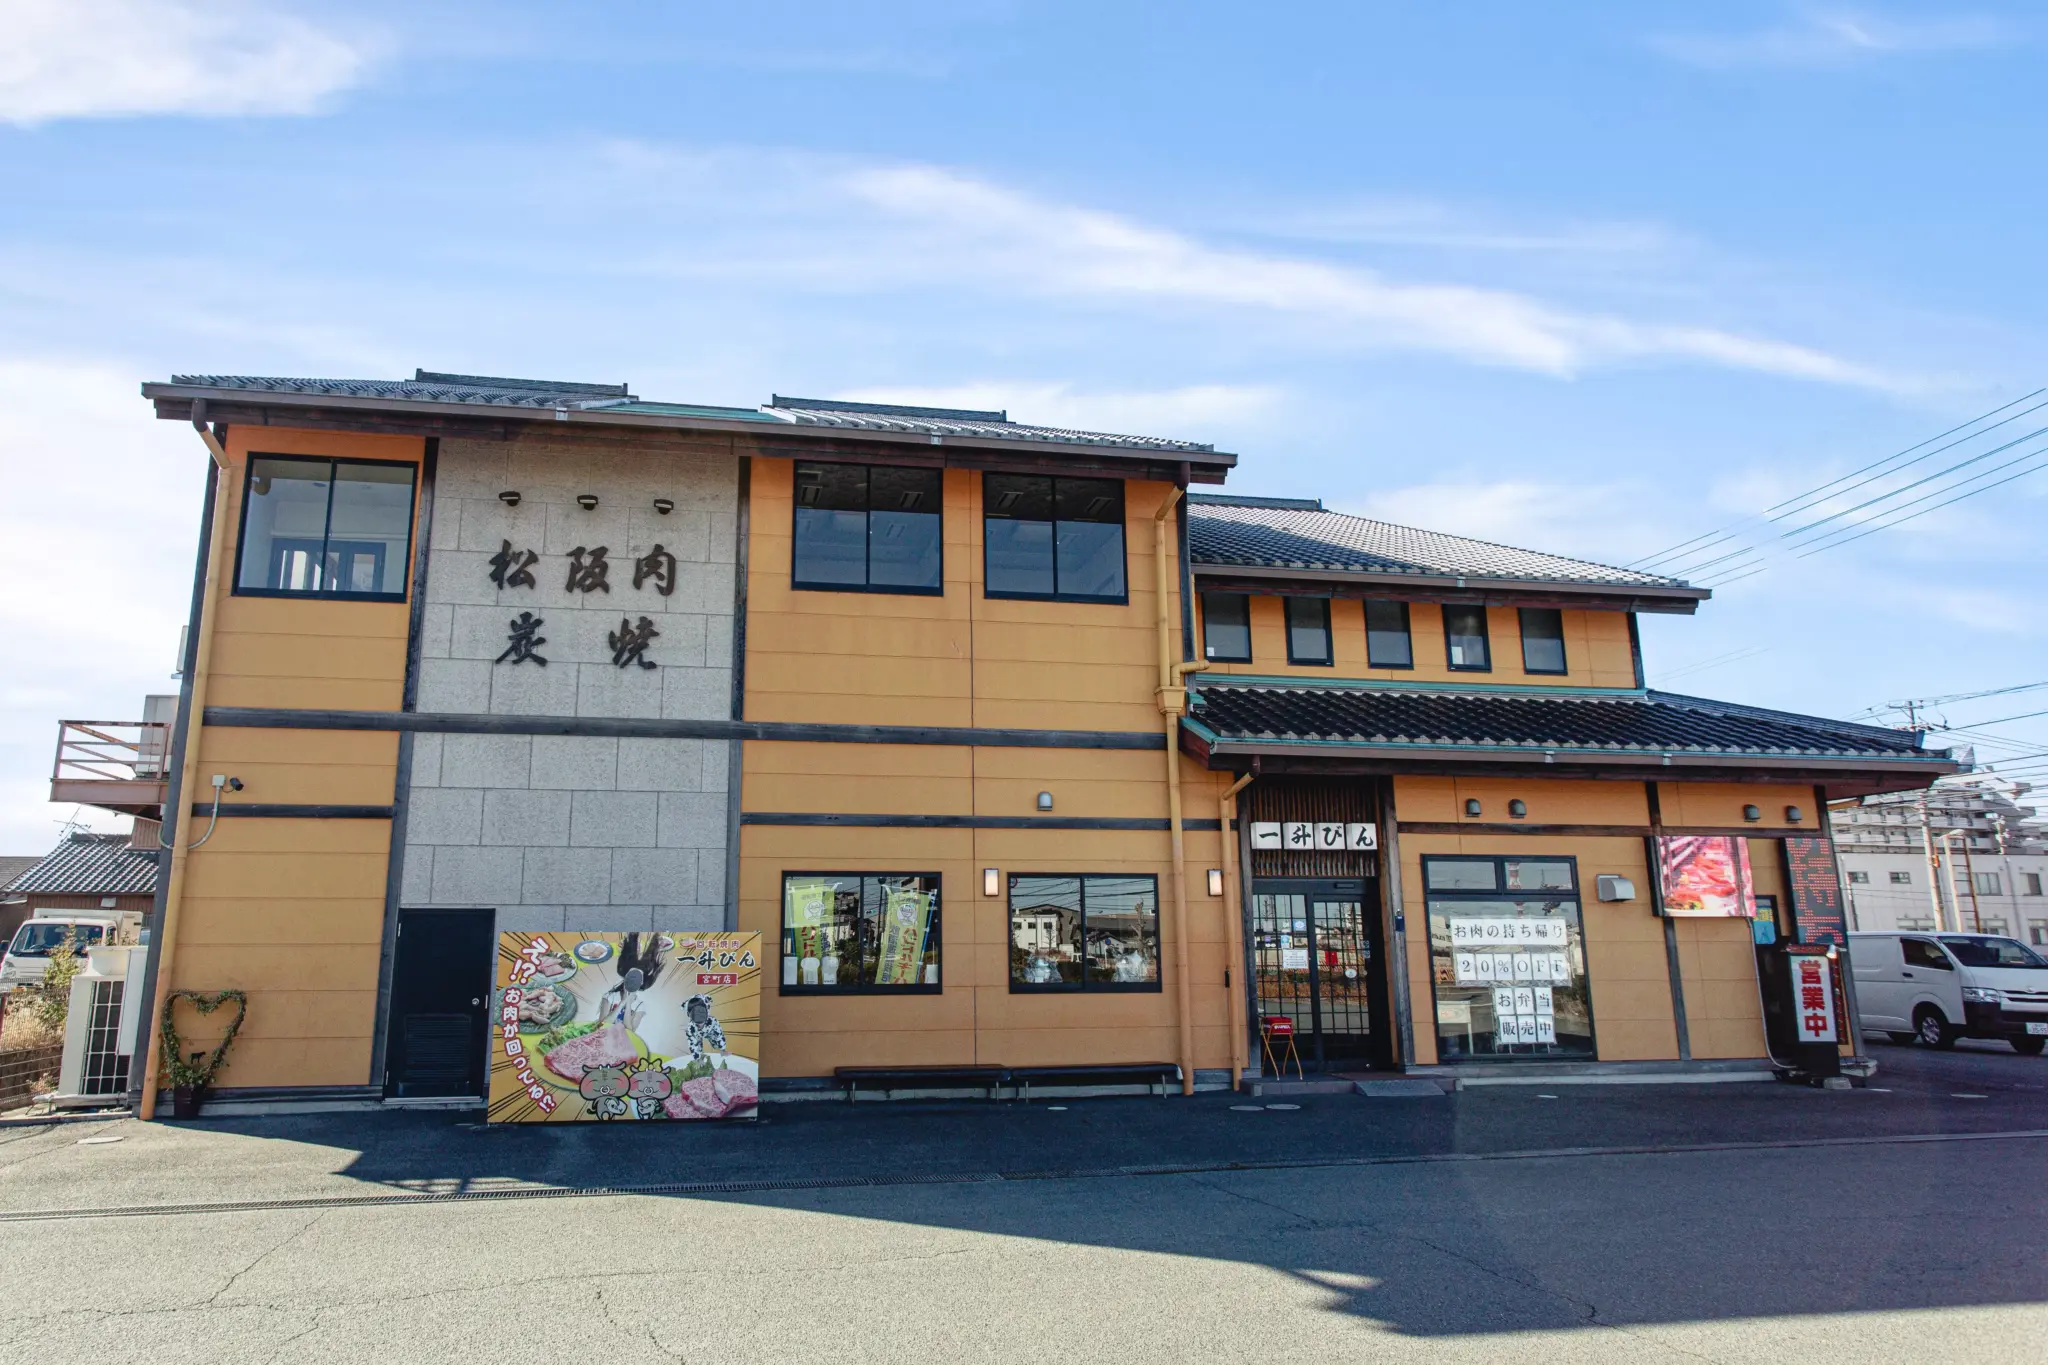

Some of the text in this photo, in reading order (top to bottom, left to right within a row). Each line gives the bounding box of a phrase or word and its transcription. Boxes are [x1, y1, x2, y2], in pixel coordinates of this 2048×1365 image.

[489, 538, 677, 597] 松阪肉
[495, 611, 661, 670] 炭焼
[1258, 823, 1374, 847] 一升びん
[1454, 923, 1563, 940] お肉の持ち帰り
[696, 940, 740, 949] 回転焼肉
[676, 950, 756, 971] 一升びん
[702, 974, 731, 984] 宮町店
[1498, 992, 1551, 1008] お弁当
[1799, 959, 1828, 1037] 営業中
[1502, 1021, 1552, 1036] 販売中
